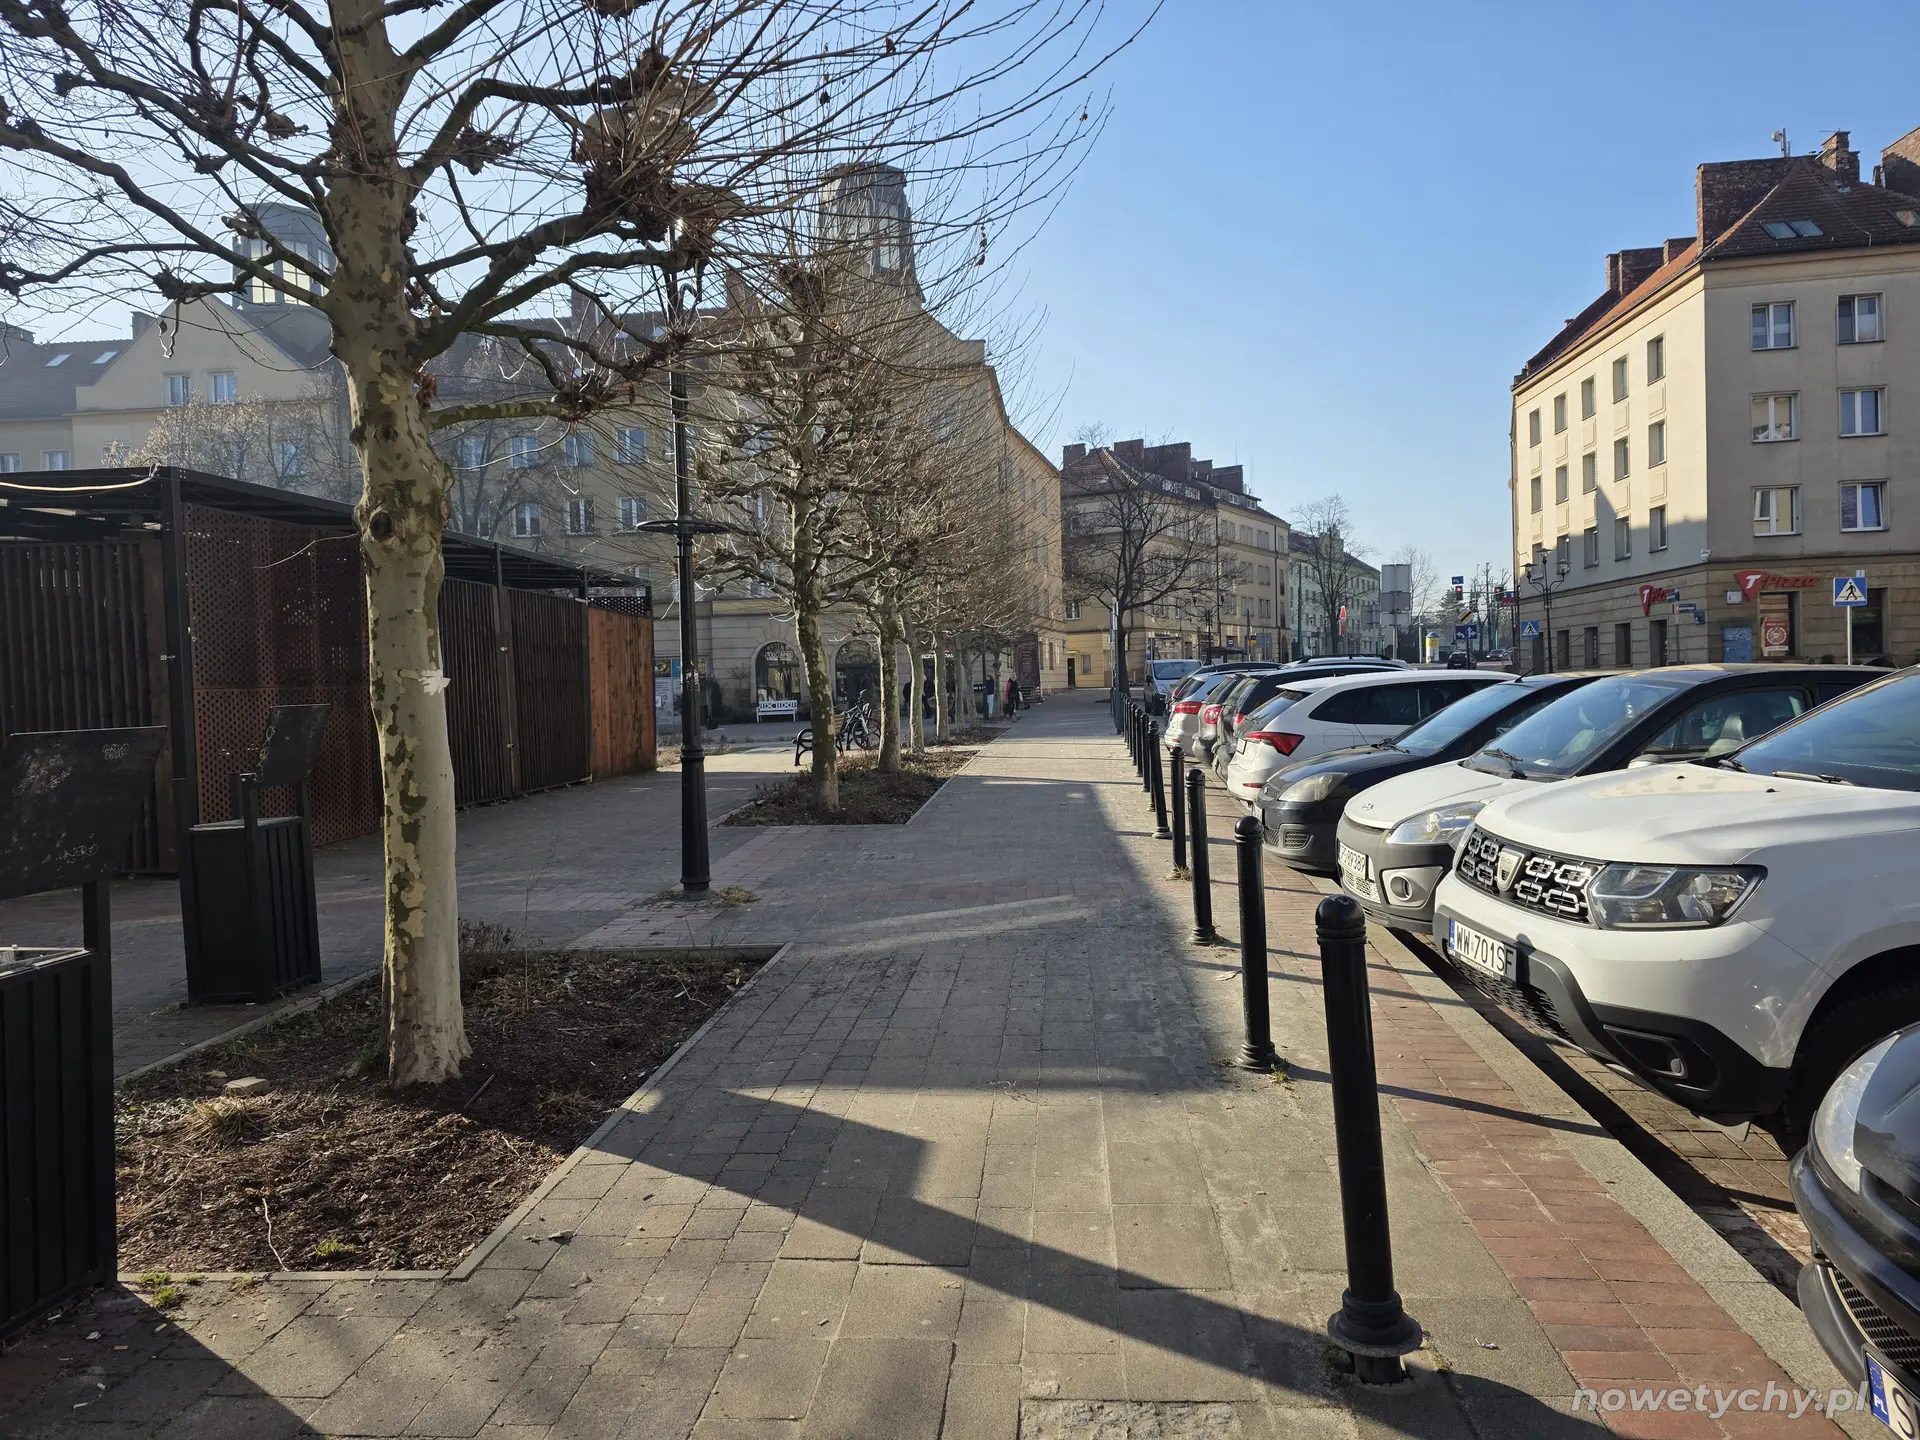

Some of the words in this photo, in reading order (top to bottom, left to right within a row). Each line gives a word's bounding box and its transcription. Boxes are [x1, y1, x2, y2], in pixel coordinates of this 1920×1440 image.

[1746, 574, 1762, 589] T
[1763, 574, 1818, 589] Pizza
[1456, 924, 1471, 956] WW
[1473, 934, 1514, 975] 701SF
[1873, 1393, 1888, 1415] PL
[1892, 1386, 1920, 1440] S
